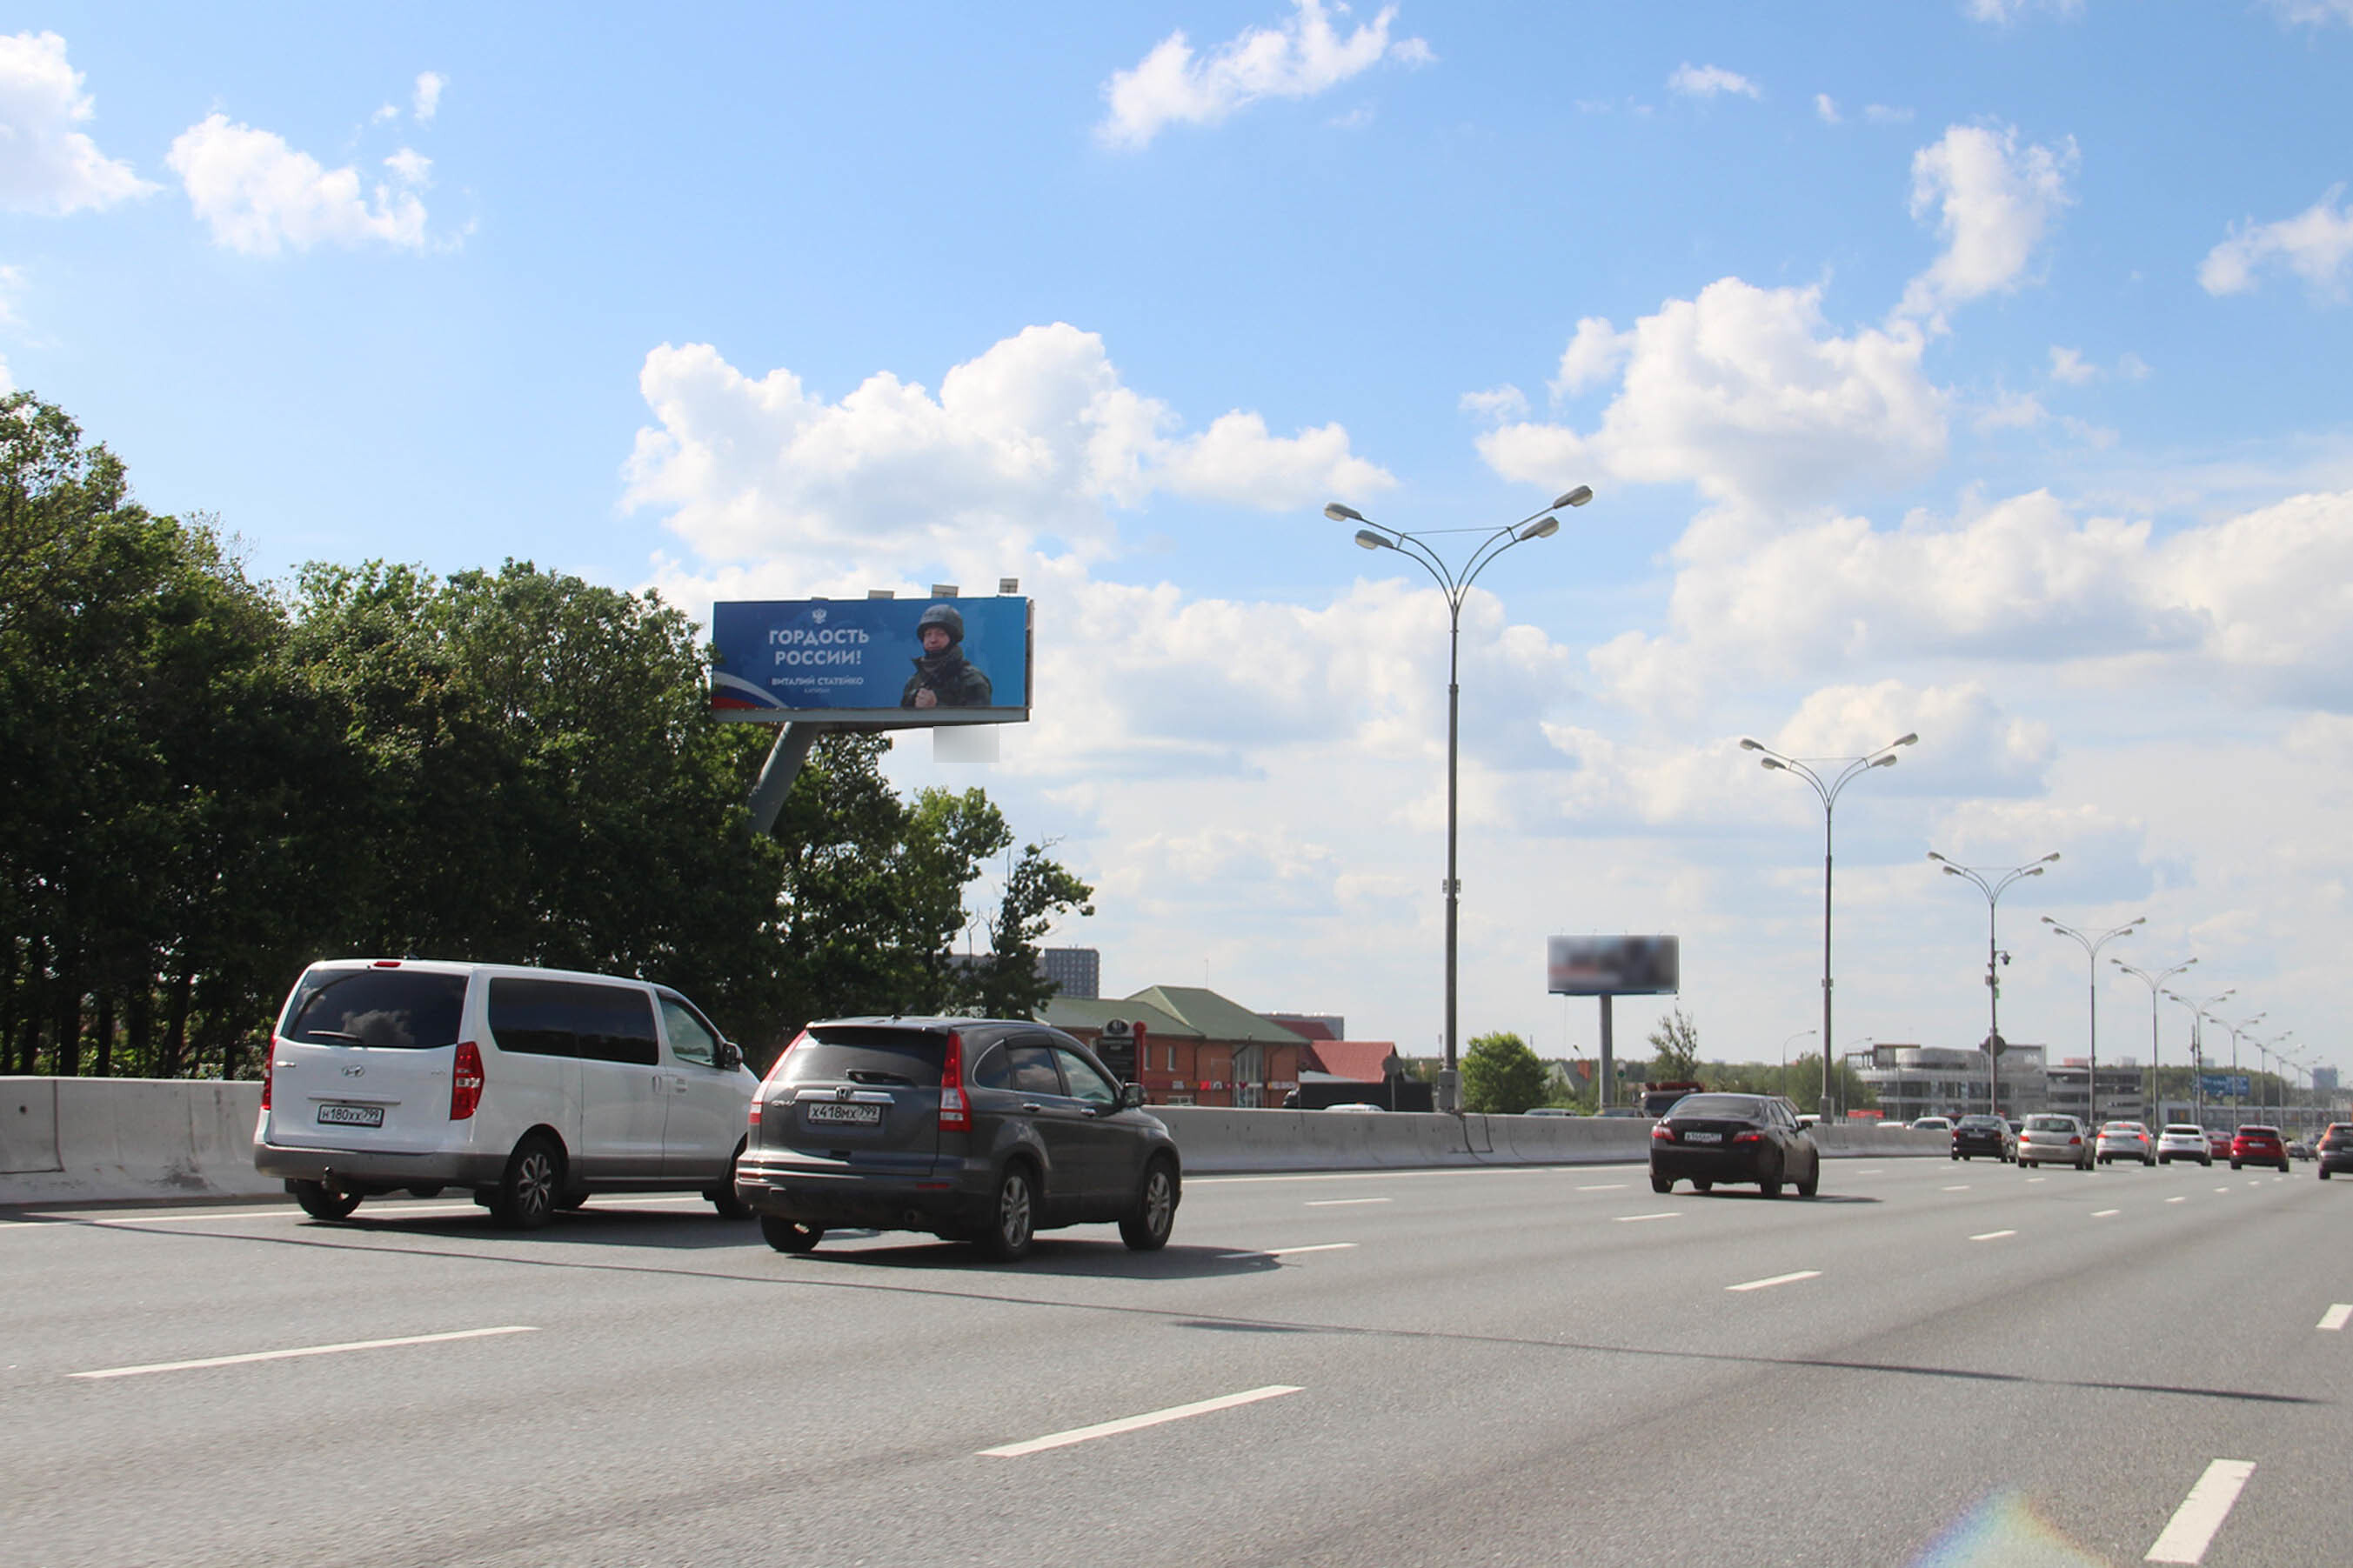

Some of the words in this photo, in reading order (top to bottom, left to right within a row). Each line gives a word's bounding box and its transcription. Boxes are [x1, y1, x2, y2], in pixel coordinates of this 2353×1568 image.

[769, 629, 870, 646] ГОРДОСТЬ
[775, 650, 862, 665] РОССИИ!
[771, 676, 815, 685] ВИТАЛИЙ
